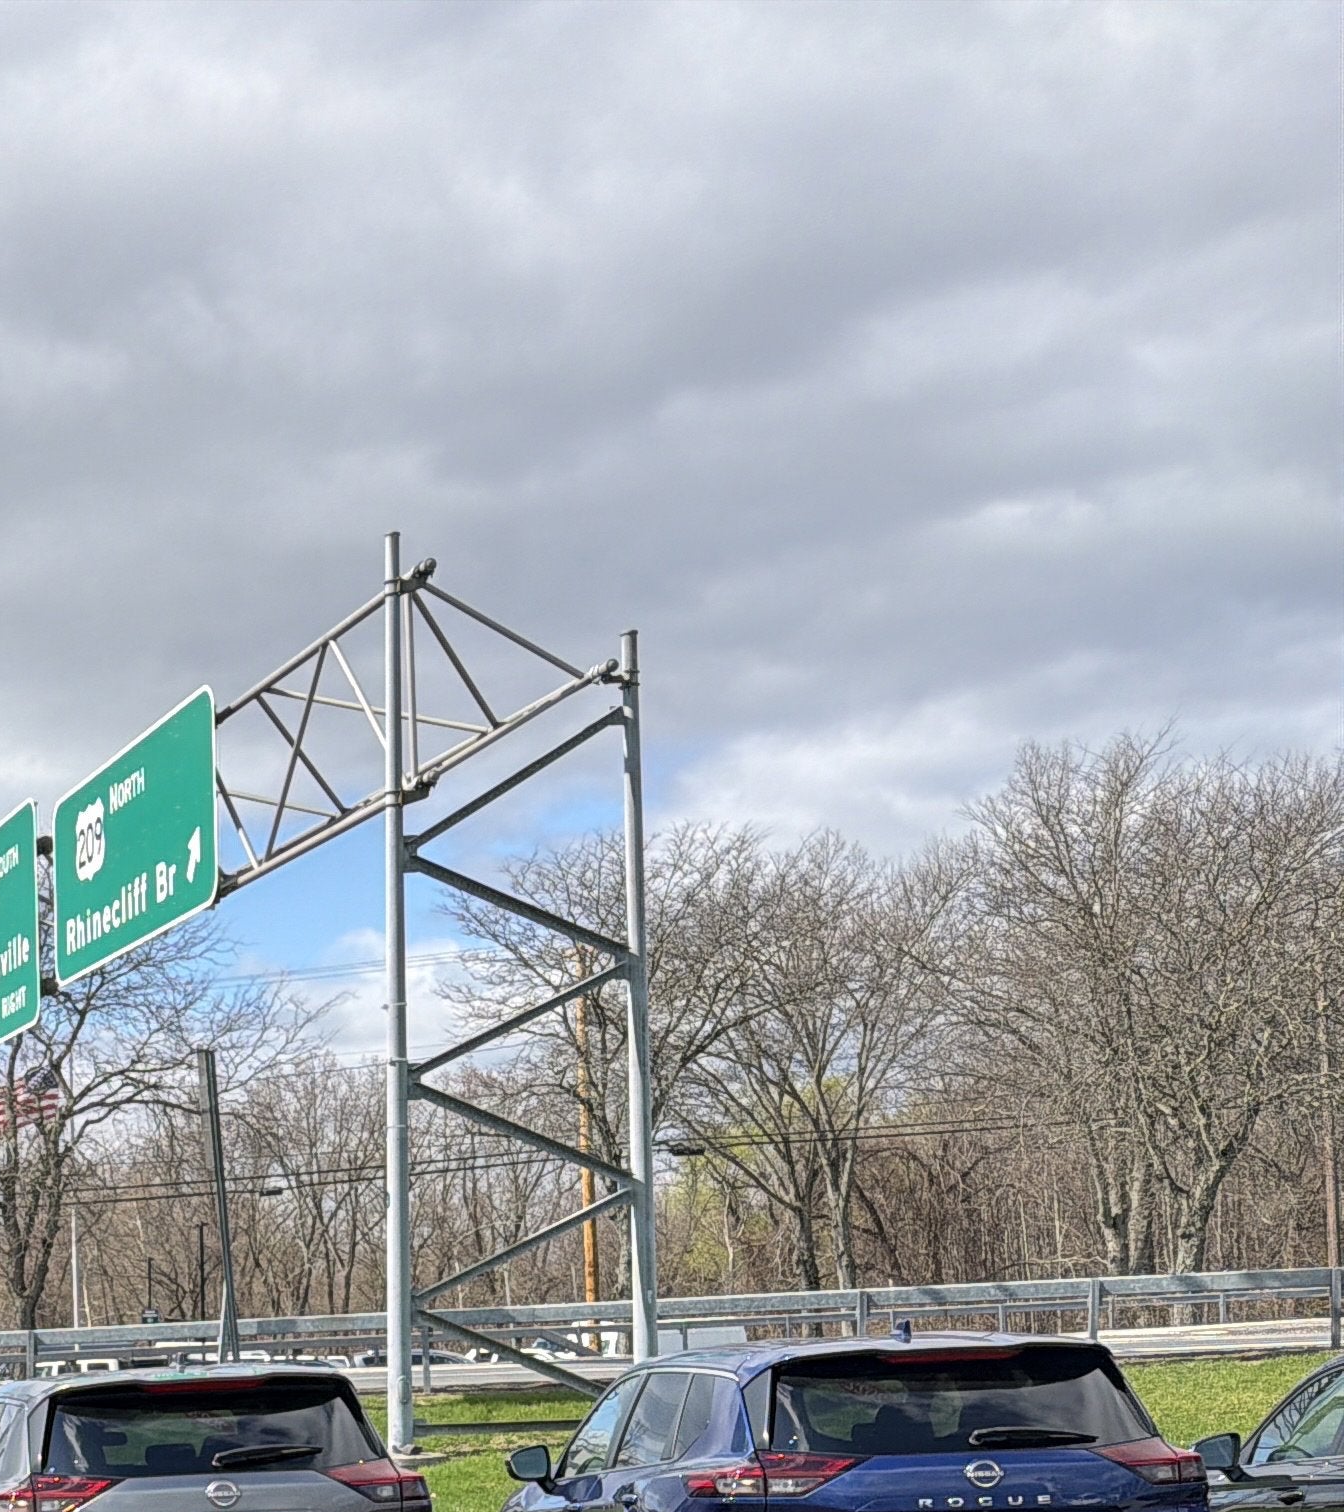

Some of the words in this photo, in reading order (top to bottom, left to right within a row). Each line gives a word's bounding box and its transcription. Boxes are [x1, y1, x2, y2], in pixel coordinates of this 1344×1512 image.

[109, 767, 145, 814] NORTH
[77, 816, 103, 870] 209
[66, 872, 148, 956] Rhinecliff
[155, 861, 177, 904] Br
[1, 986, 27, 1019] RIGHT
[918, 1494, 1052, 1509] ROGUE
